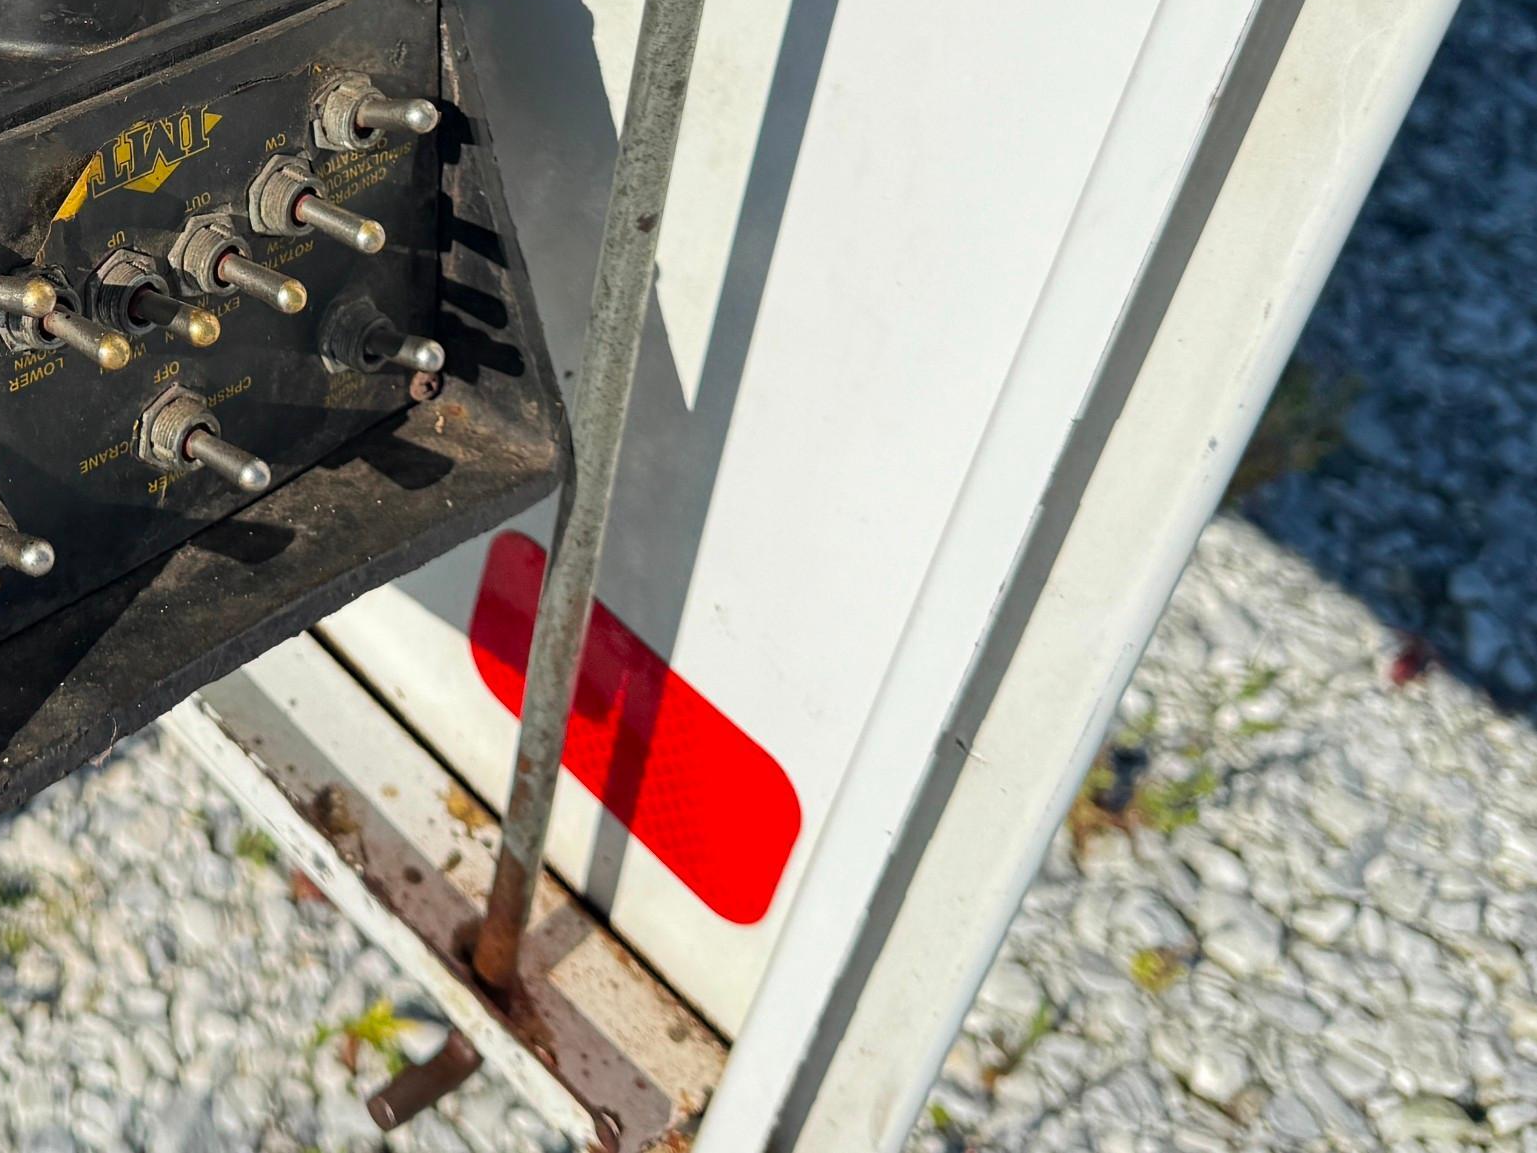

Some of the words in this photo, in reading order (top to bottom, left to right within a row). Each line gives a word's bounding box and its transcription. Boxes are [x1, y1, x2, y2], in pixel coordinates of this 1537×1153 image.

[264, 132, 286, 151] CW
[184, 190, 211, 214] OUT
[106, 229, 126, 248] UP
[9, 358, 65, 392] LOWER
[153, 360, 180, 385] OFF
[79, 440, 130, 475] CRANE
